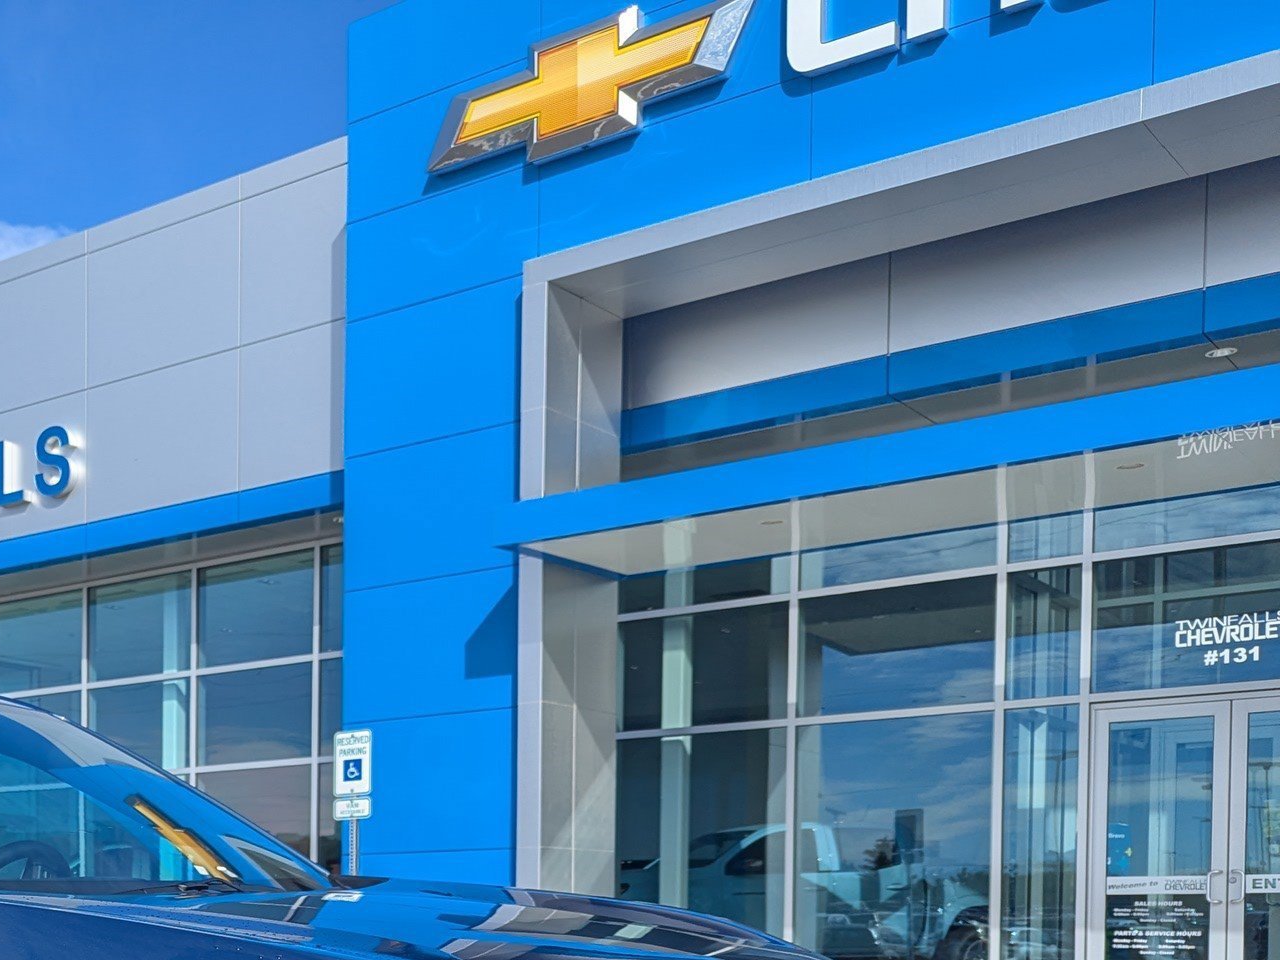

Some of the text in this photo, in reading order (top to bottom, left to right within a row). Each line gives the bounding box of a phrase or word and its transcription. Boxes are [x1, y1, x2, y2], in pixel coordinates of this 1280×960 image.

[1175, 621, 1280, 648] CHEVROLE
[1204, 646, 1259, 666] #131
[337, 735, 370, 746] RESERVED
[339, 747, 366, 756] PARKING
[1108, 882, 1147, 890] Welcome
[1252, 878, 1280, 889] EN
